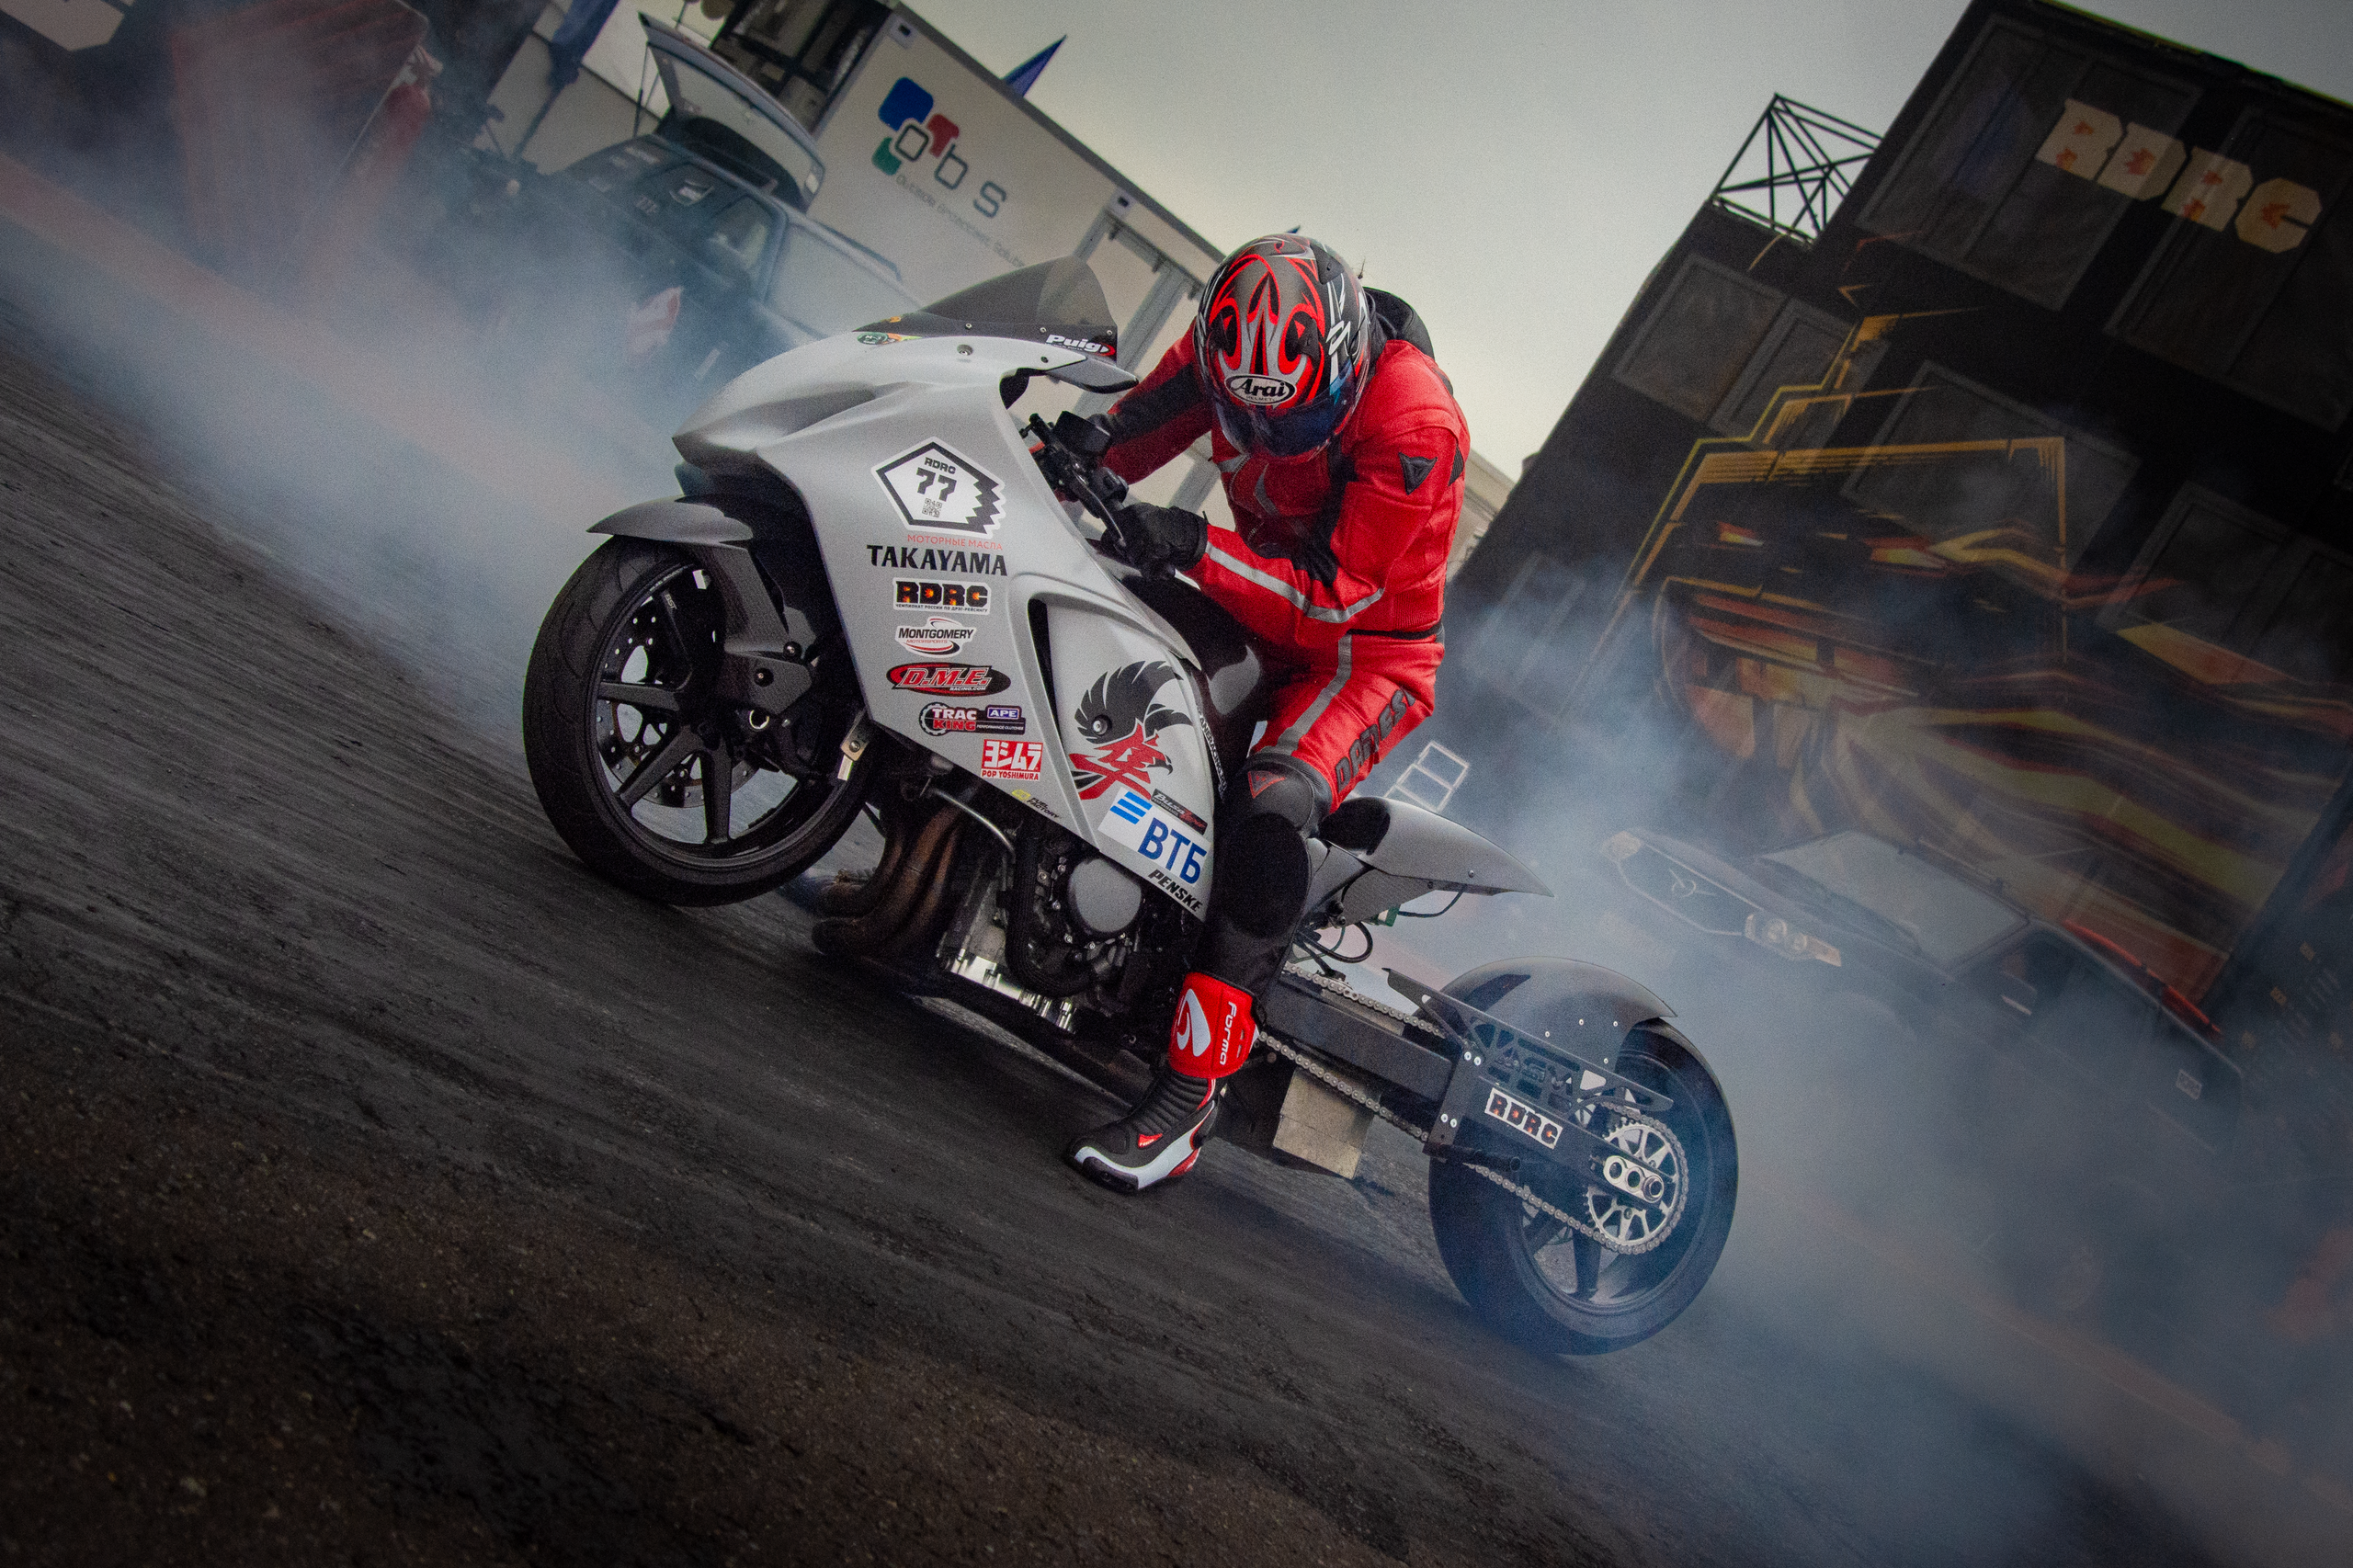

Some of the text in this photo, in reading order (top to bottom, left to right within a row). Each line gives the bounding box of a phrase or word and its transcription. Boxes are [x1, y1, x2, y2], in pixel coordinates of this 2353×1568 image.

[2035, 97, 2323, 254] RDRC
[1046, 334, 1102, 353] Puig
[1233, 378, 1287, 397] Arai
[924, 457, 957, 474] RDRC
[916, 467, 957, 502] 77
[907, 534, 1003, 551] МОТОРНЫЕ МАСЛА
[866, 544, 1007, 576] TAKAYAMA
[896, 581, 988, 608] RDRC
[898, 628, 974, 640] MONTGOMERY
[898, 668, 992, 688] D.M.E.
[932, 708, 977, 720] TRAC
[990, 710, 1017, 718] APE
[933, 720, 976, 731] KING
[984, 740, 1042, 770] ヨシムラ
[982, 769, 1039, 780] POP YOSHIMURA
[1027, 800, 1059, 818] FACTORY
[1031, 797, 1048, 808] FUEL
[1138, 817, 1207, 884] ВТБ
[1148, 869, 1202, 912] PENSKE
[1488, 1092, 1560, 1145] RDRC
